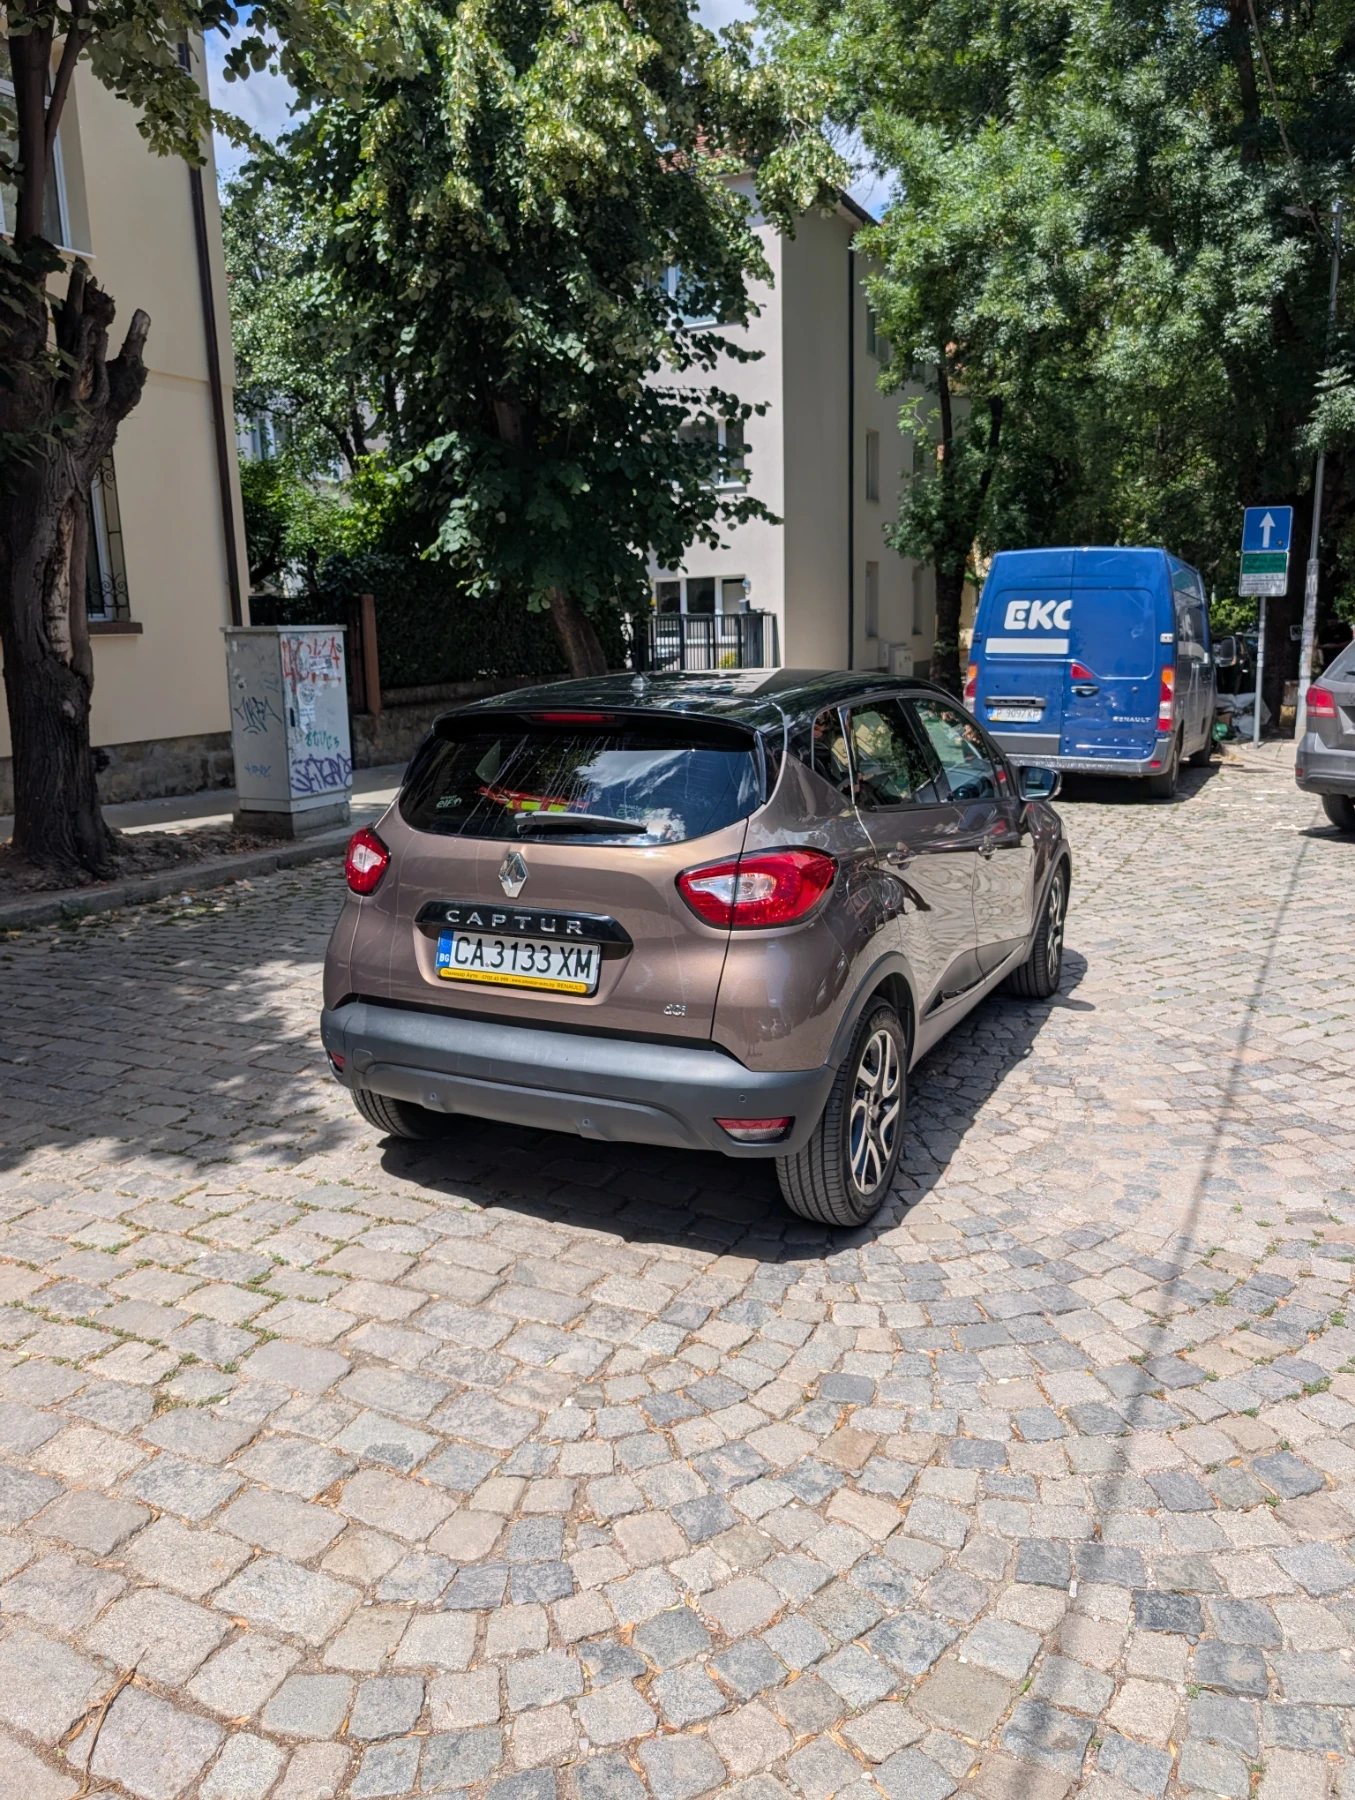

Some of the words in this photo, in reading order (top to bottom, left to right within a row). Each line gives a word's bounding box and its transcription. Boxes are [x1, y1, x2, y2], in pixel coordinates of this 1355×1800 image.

[445, 910, 583, 935] CAPTUR
[439, 953, 449, 962] BG
[557, 946, 593, 979] XM
